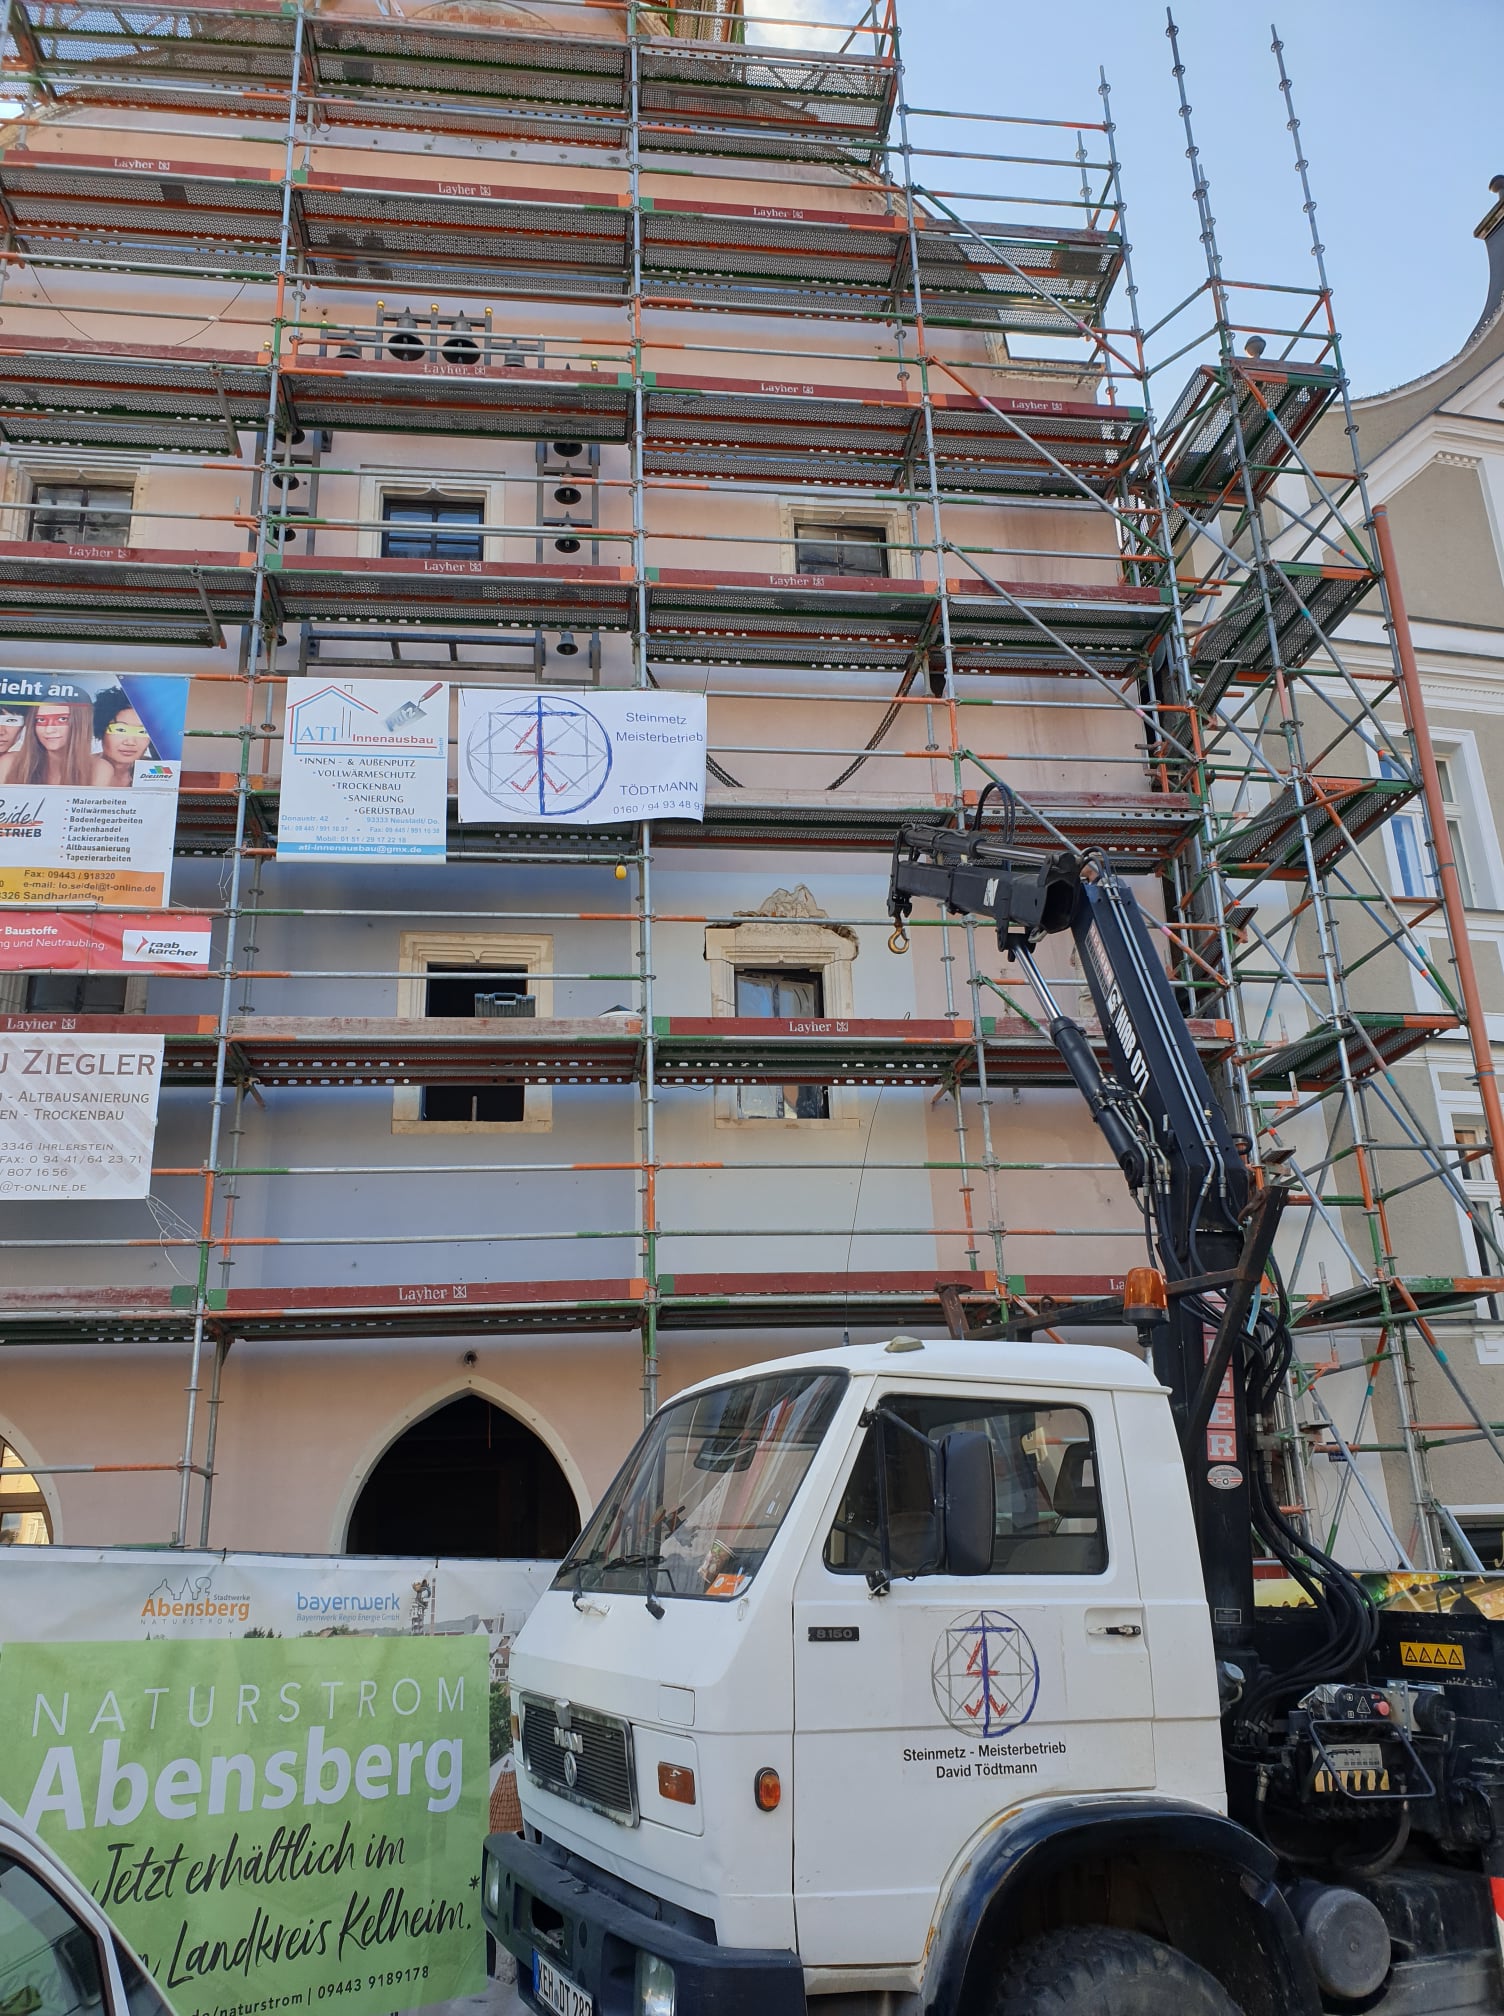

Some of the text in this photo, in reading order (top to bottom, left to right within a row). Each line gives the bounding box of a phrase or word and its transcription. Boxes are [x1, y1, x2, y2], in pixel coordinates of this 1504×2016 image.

[114, 159, 154, 170] Layher
[438, 182, 476, 196] Layher
[753, 207, 787, 219] Layher
[424, 364, 468, 376] Layher
[760, 382, 798, 394] Layher
[1011, 399, 1048, 411] Layher
[69, 546, 113, 558] Layher
[424, 560, 465, 573] Layher
[769, 575, 809, 587] Layher
[0, 679, 79, 697] ieht an.
[626, 712, 688, 725] Steinmetz
[300, 726, 434, 744] ATI Innenausbau
[616, 732, 703, 744] Meisterbetrieb
[347, 758, 354, 766] &
[318, 769, 416, 779] VOLLWÄRMESCHUTZ
[336, 782, 401, 791] TROCKENBAU
[619, 781, 698, 796] TÖDTMANN
[72, 798, 127, 806] Malerarbeiten
[348, 794, 404, 803] SANIERUNG
[0, 797, 45, 825] eidel
[71, 807, 137, 815] Vollwärmeschutz
[358, 806, 415, 815] GERÜSTBAU
[613, 805, 638, 814] 0160
[647, 802, 659, 811] 94
[663, 801, 676, 809] 93
[679, 800, 691, 808] 48
[69, 816, 143, 824] Bodenlegearbeiten
[68, 825, 121, 833] Farbenhandel
[67, 835, 129, 843] Lackierarbeiten
[66, 844, 131, 853] Altbausanierung
[298, 844, 422, 853] ati-innenausbau@gmx.de
[66, 853, 132, 862] Tapezierarbeiten
[24, 869, 45, 878] Fax:
[48, 871, 76, 879] 09443
[83, 872, 116, 880] 918320
[23, 881, 157, 893] e-mail: lo.seidel@t-online.de
[0, 891, 104, 902] 326 Sandharlanden
[5, 926, 58, 935] Baustoffe
[13, 938, 34, 948] und
[150, 941, 180, 949] raab
[148, 947, 199, 957] karcher
[789, 1021, 831, 1033] Layher
[1114, 1005, 1151, 1097] HIAB 071
[21, 1049, 156, 1076] ZIEGLER
[43, 1155, 59, 1164] 94
[108, 1155, 123, 1164] 23
[129, 1156, 142, 1164] 71
[398, 1286, 448, 1302] Layher
[297, 1592, 400, 1614] bayernwerk
[141, 1598, 250, 1622] Abensberg
[31, 1676, 466, 1737] NATURSTROM
[554, 1727, 583, 1753] MAN
[903, 1747, 966, 1762] Steinmetz
[978, 1741, 1067, 1758] Meisterbetrieb
[936, 1762, 1038, 1779] David Tödtmann
[22, 1725, 463, 1833] Abensberg
[90, 1820, 407, 1908] Jetzt erhältlich im
[166, 1906, 333, 1989] Landkreis
[317, 1978, 362, 1999] 09443
[368, 1965, 430, 1989] 9189178
